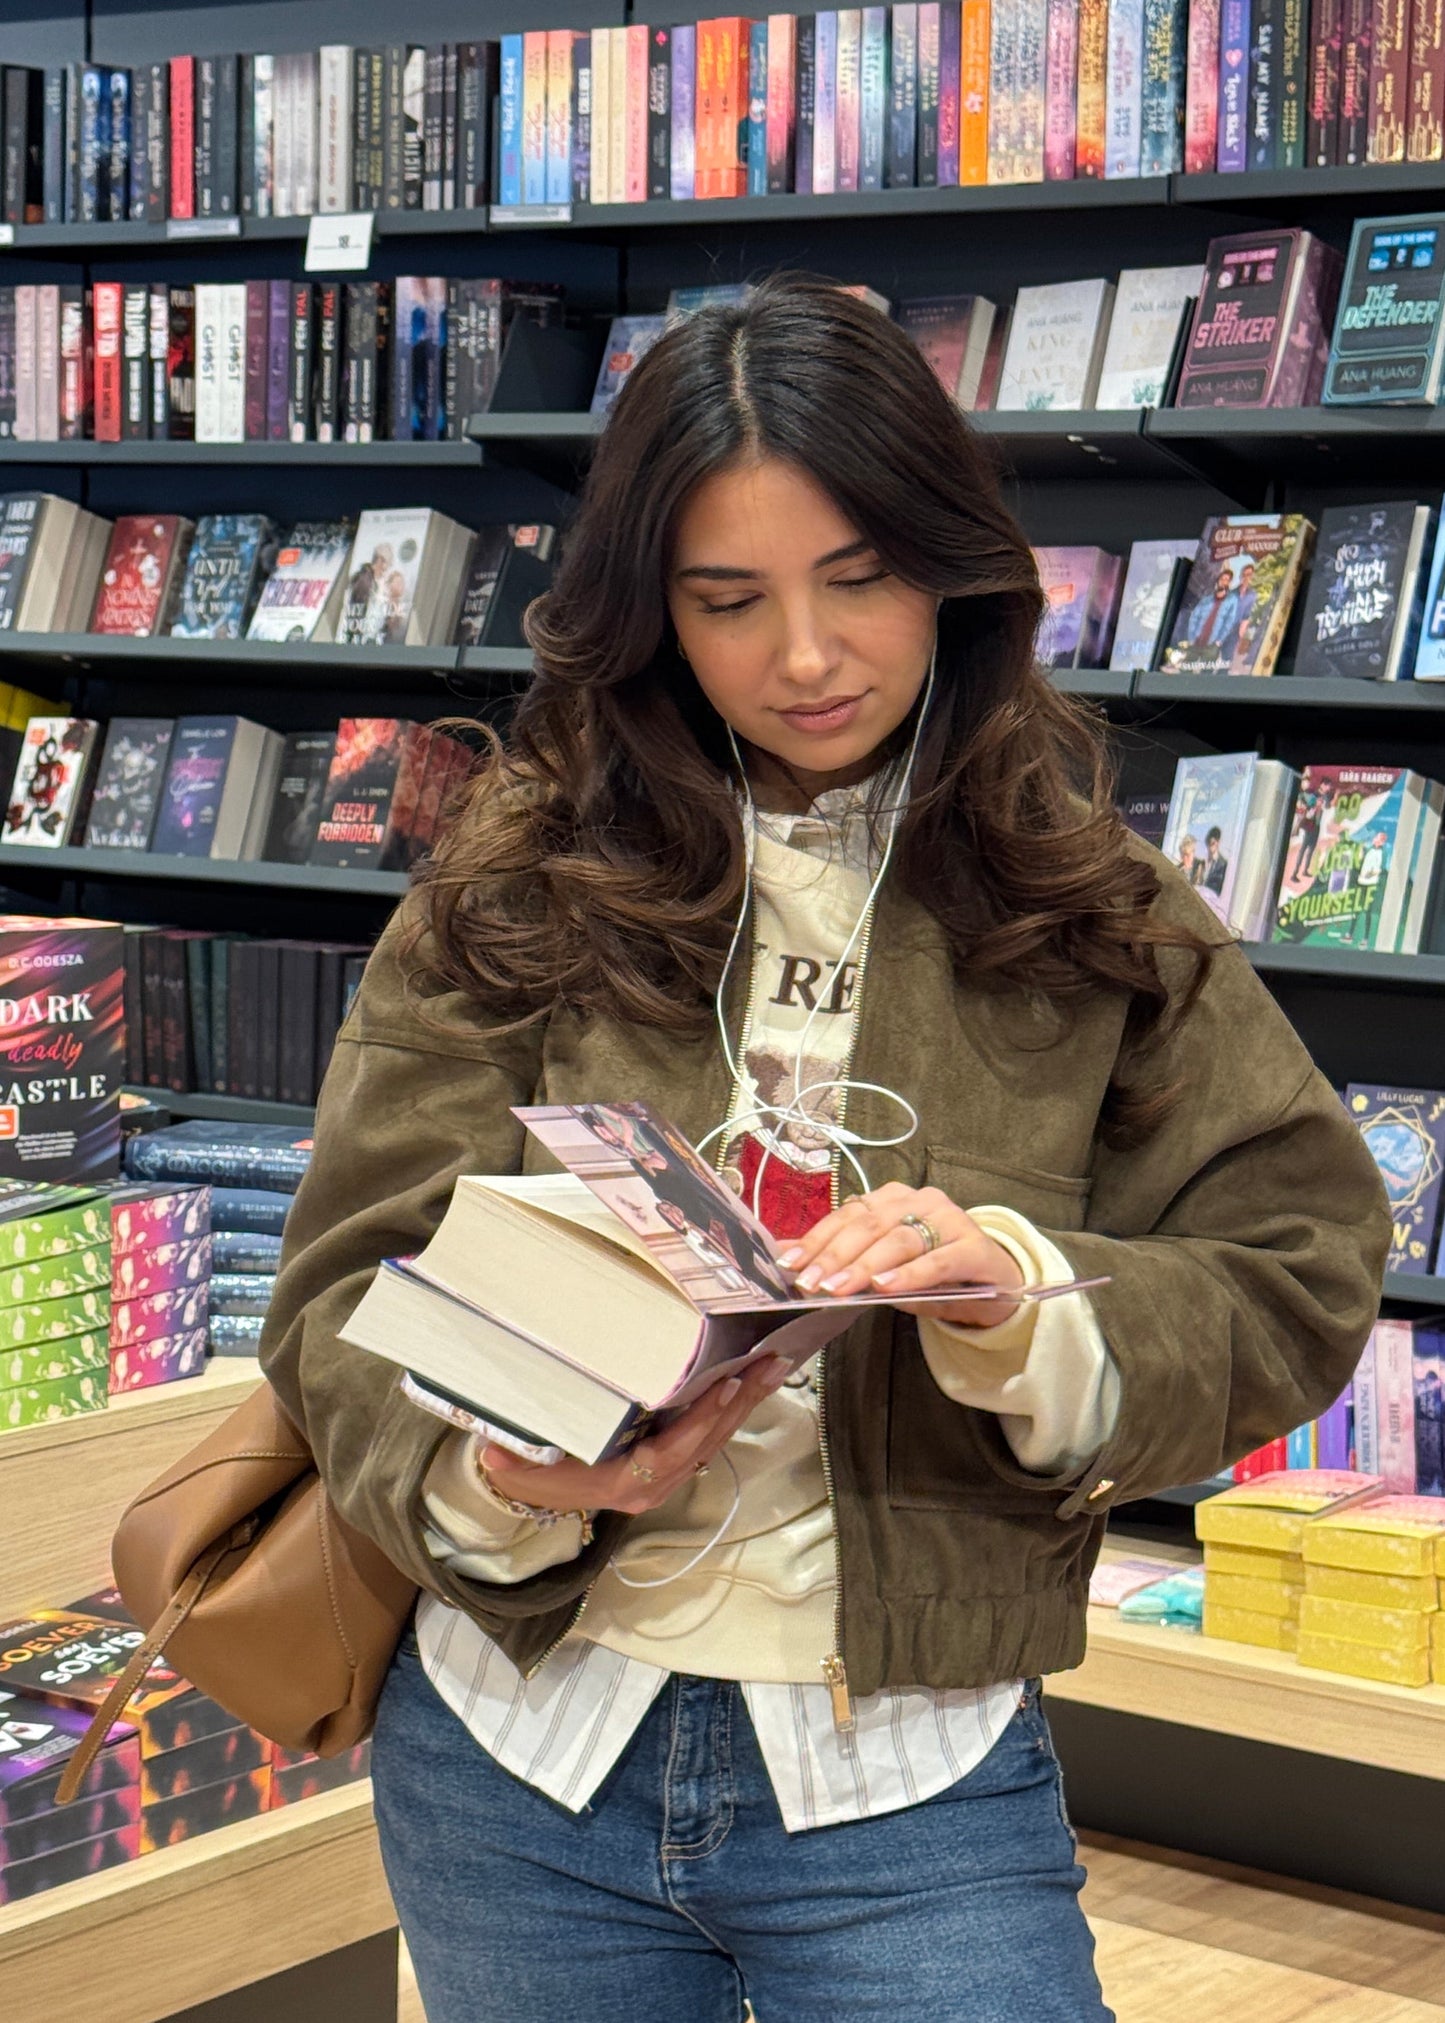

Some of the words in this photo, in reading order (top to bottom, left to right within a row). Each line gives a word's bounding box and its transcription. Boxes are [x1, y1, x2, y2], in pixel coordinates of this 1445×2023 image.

[1258, 24, 1273, 55] SAY
[1256, 60, 1271, 86] MY
[1254, 90, 1271, 141] NAME
[296, 290, 308, 317] PAL
[323, 290, 335, 318] PAL
[1364, 283, 1398, 308] THE
[1213, 301, 1244, 323] THE
[1341, 300, 1439, 331] DEFENDER
[295, 319, 308, 351] PEN
[322, 319, 335, 351] PEN
[1193, 316, 1277, 349] STRIKER
[202, 324, 216, 384] GHOST
[228, 323, 242, 384] GHOST
[1189, 382, 1212, 395] ANA
[1217, 377, 1258, 392] HUANG
[1339, 369, 1368, 384] ANA
[1371, 364, 1417, 381] HUANG
[1214, 528, 1243, 543] CLUB
[331, 801, 378, 822] DEEPLY
[1128, 801, 1156, 816] JOSI
[1335, 792, 1362, 823] GO
[317, 821, 386, 844] FORBIDDEN
[1288, 885, 1377, 923] YOURSELF
[0, 992, 95, 1026] DARK
[8, 1031, 84, 1071] deadly
[0, 1073, 107, 1105] ASTLE
